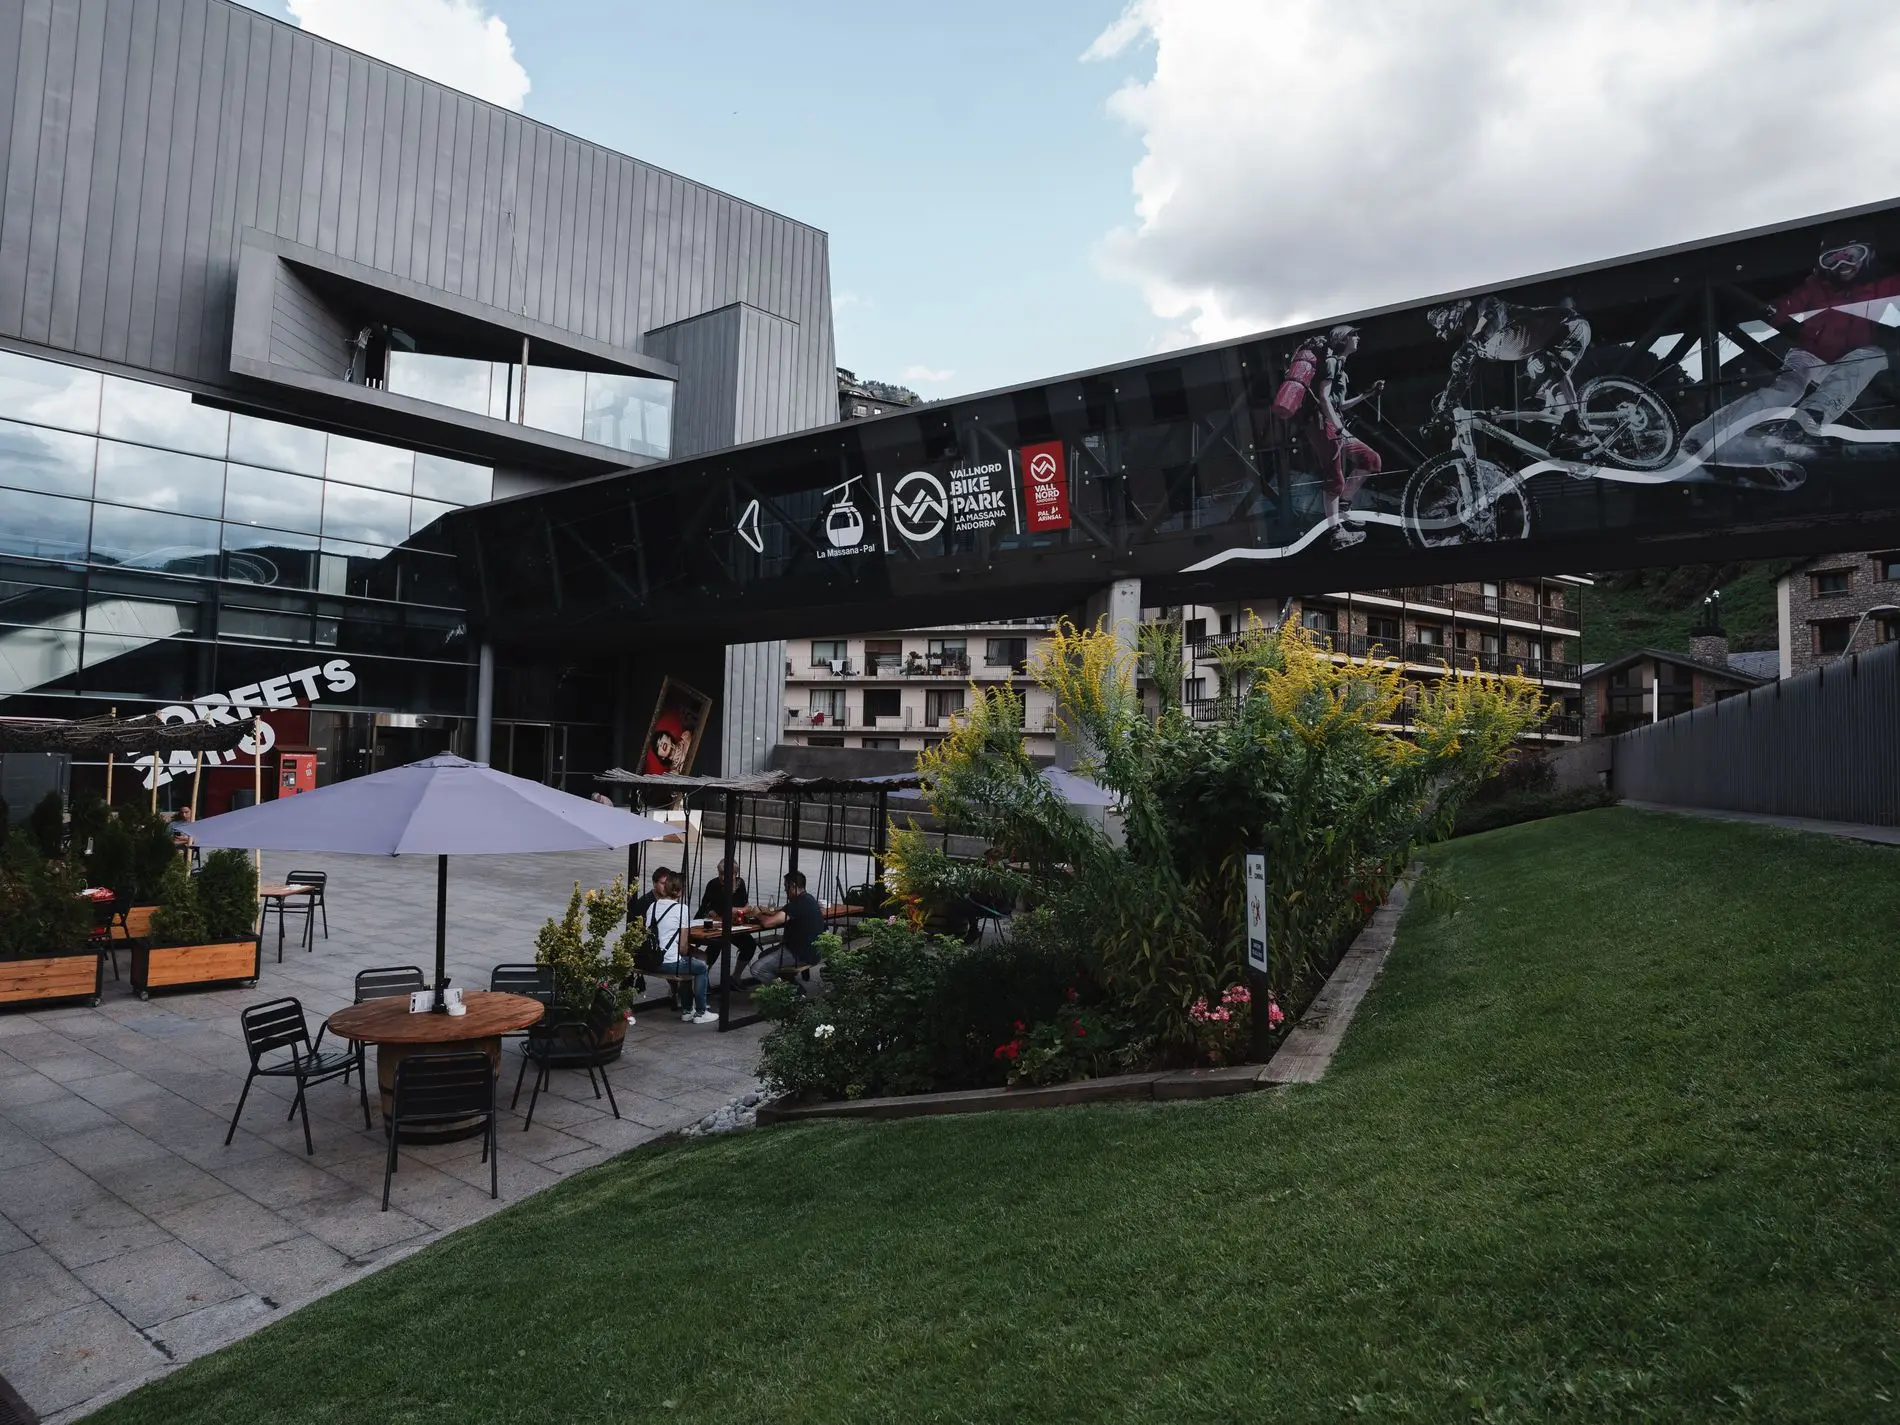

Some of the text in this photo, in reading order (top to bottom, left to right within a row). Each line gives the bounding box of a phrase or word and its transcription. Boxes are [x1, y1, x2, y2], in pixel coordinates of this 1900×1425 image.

[950, 463, 1002, 479] VALLNORD
[950, 476, 991, 495] BIKE
[1034, 483, 1057, 492] VALL
[952, 490, 1006, 514] PARK
[1035, 489, 1060, 500] NORD
[954, 509, 1007, 524] LA MASSANA
[955, 519, 996, 532] ANDORRA
[816, 550, 826, 559] La
[127, 659, 356, 735] ORFETS
